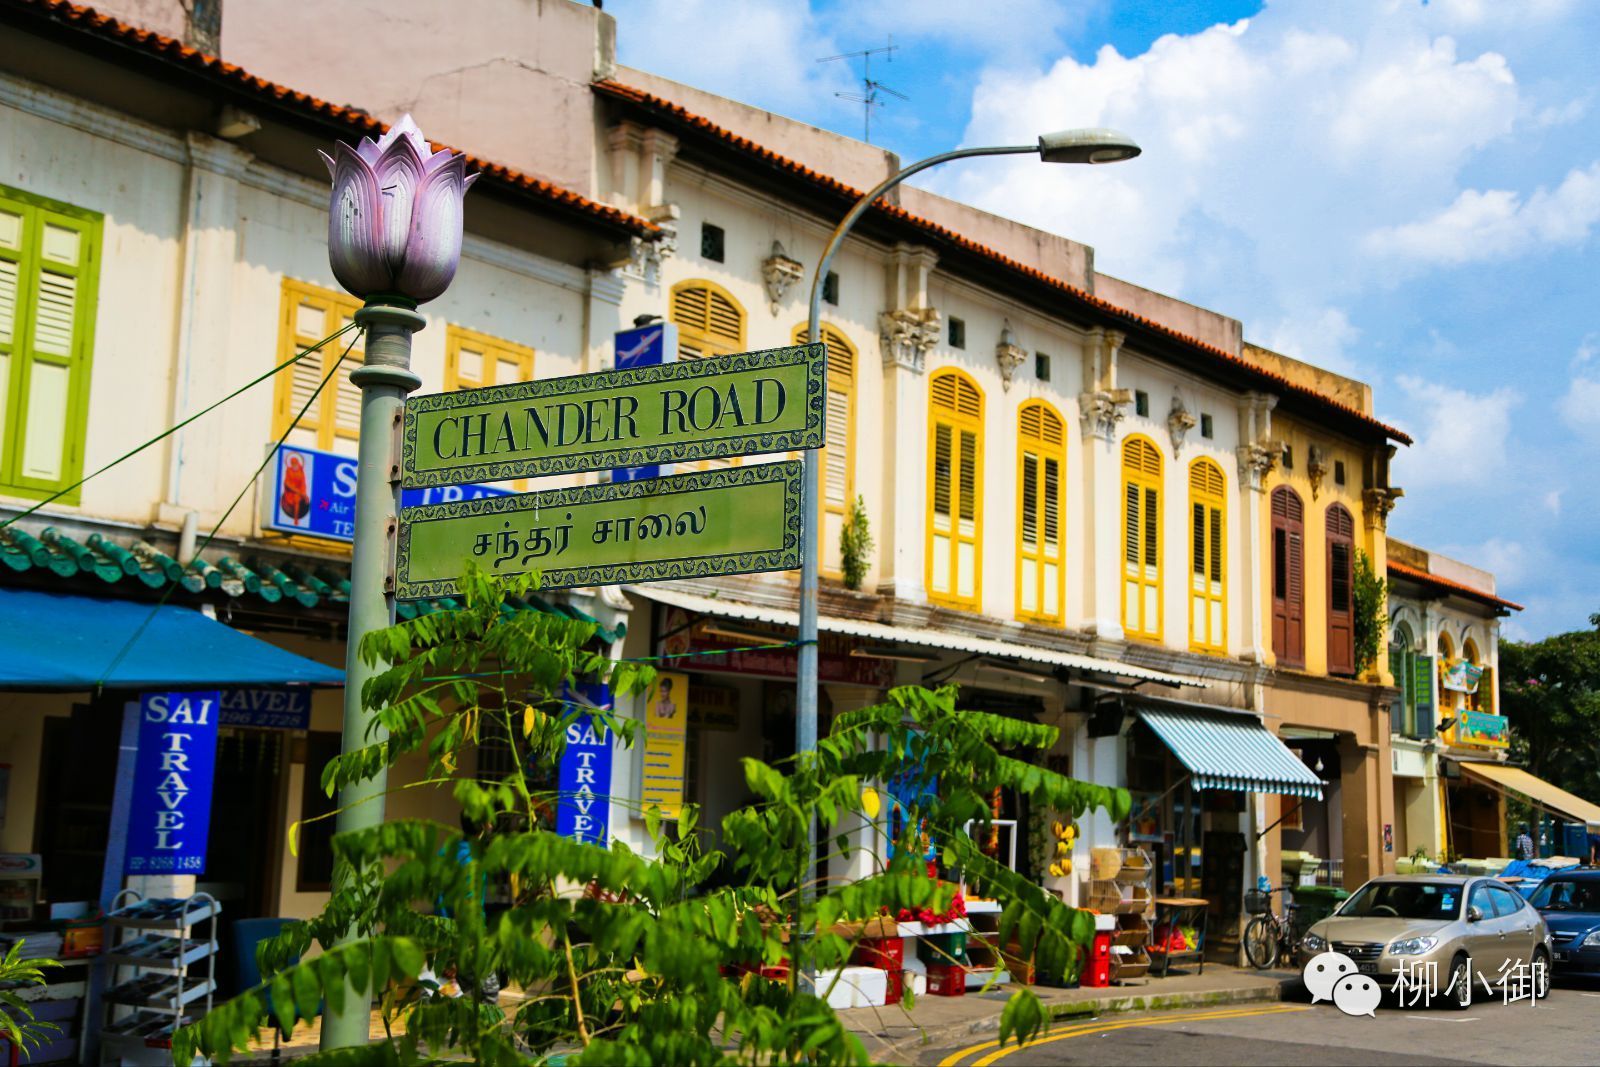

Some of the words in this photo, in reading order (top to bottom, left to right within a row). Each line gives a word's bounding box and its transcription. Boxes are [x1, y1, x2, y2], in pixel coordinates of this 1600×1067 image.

[433, 396, 640, 460] CHANDER
[658, 378, 786, 436] ROAD
[333, 520, 355, 536] TE
[472, 512, 574, 568] சந்தர்
[591, 505, 707, 544] சாலை
[146, 696, 213, 725] SAI
[566, 723, 609, 746] SAI
[154, 733, 193, 849] TRAVEL
